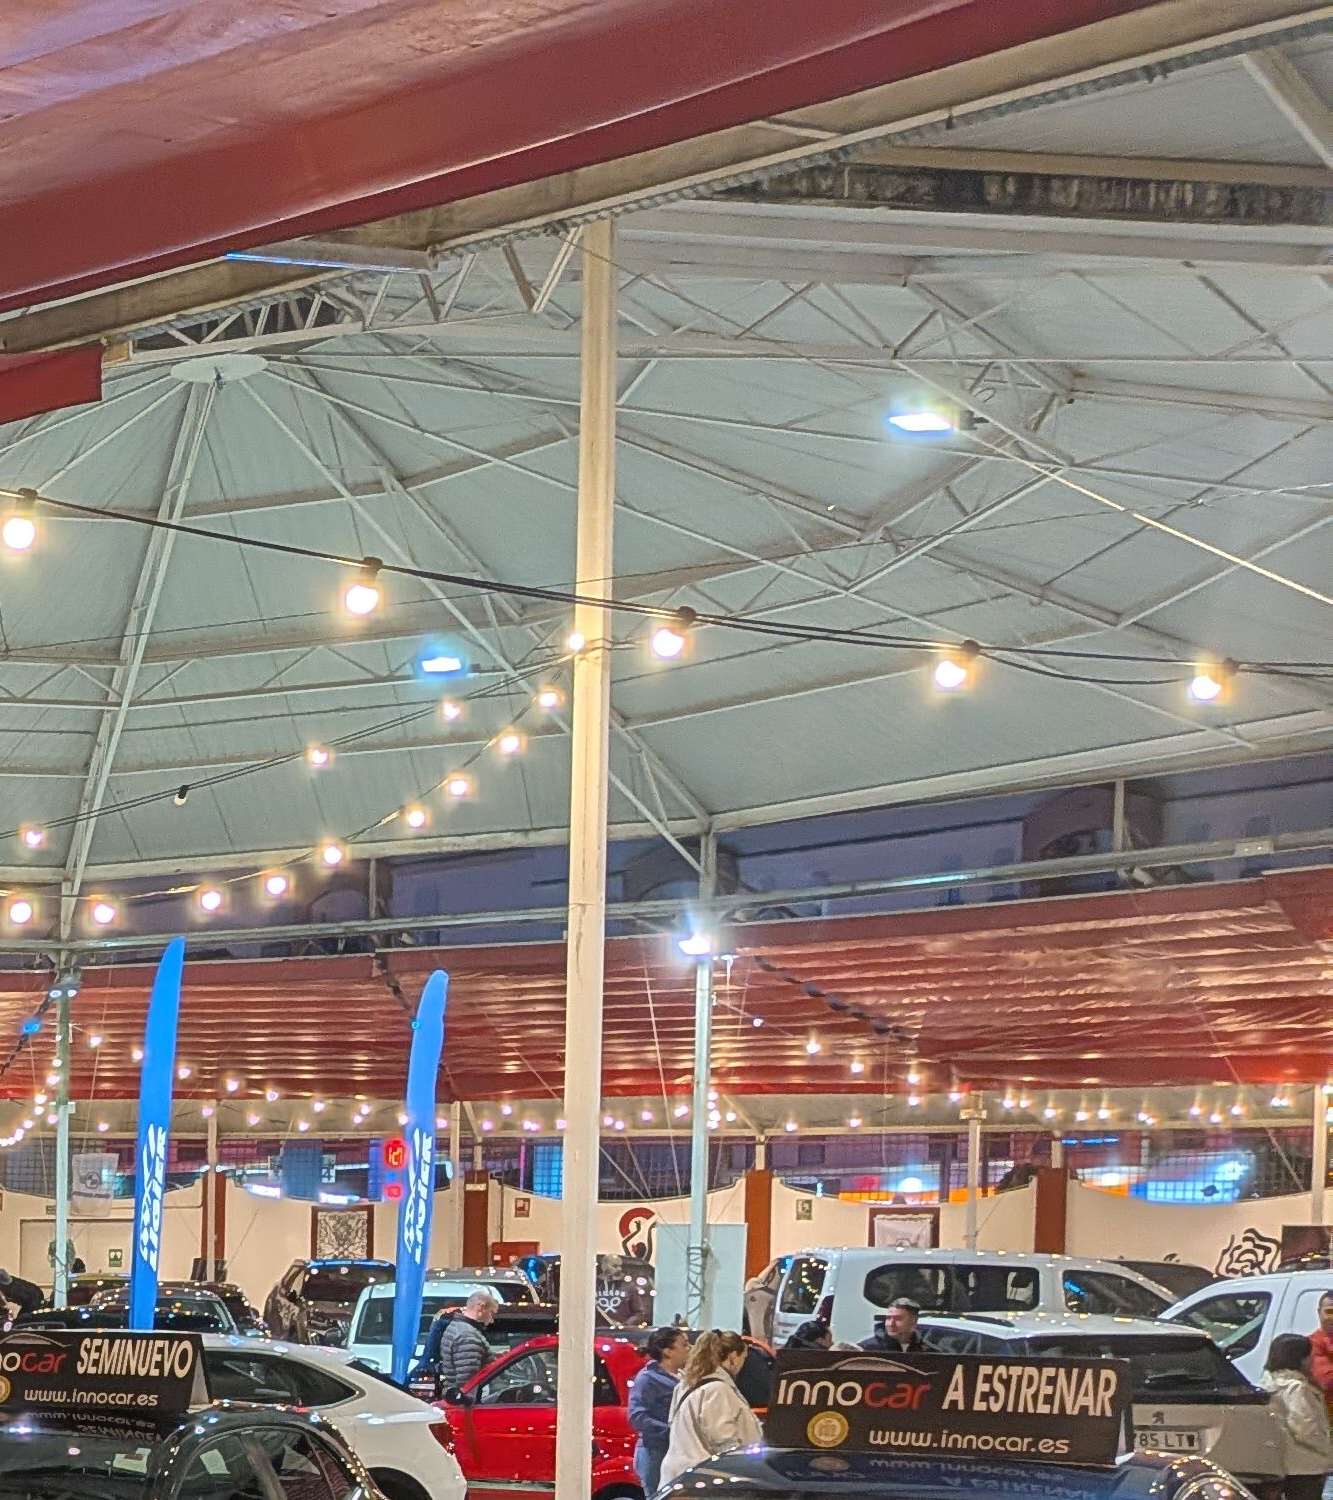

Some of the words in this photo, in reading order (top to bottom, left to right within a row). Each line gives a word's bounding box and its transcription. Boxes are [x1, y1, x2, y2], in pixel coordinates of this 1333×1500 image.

[76, 1337, 194, 1379] SEMINUEVO
[24, 1387, 159, 1407] www.innocar.es
[942, 1364, 967, 1411] A
[972, 1364, 1119, 1418] ESTRENAR
[868, 1427, 1071, 1454] www.innocar.es
[1133, 1433, 1159, 1448] 85
